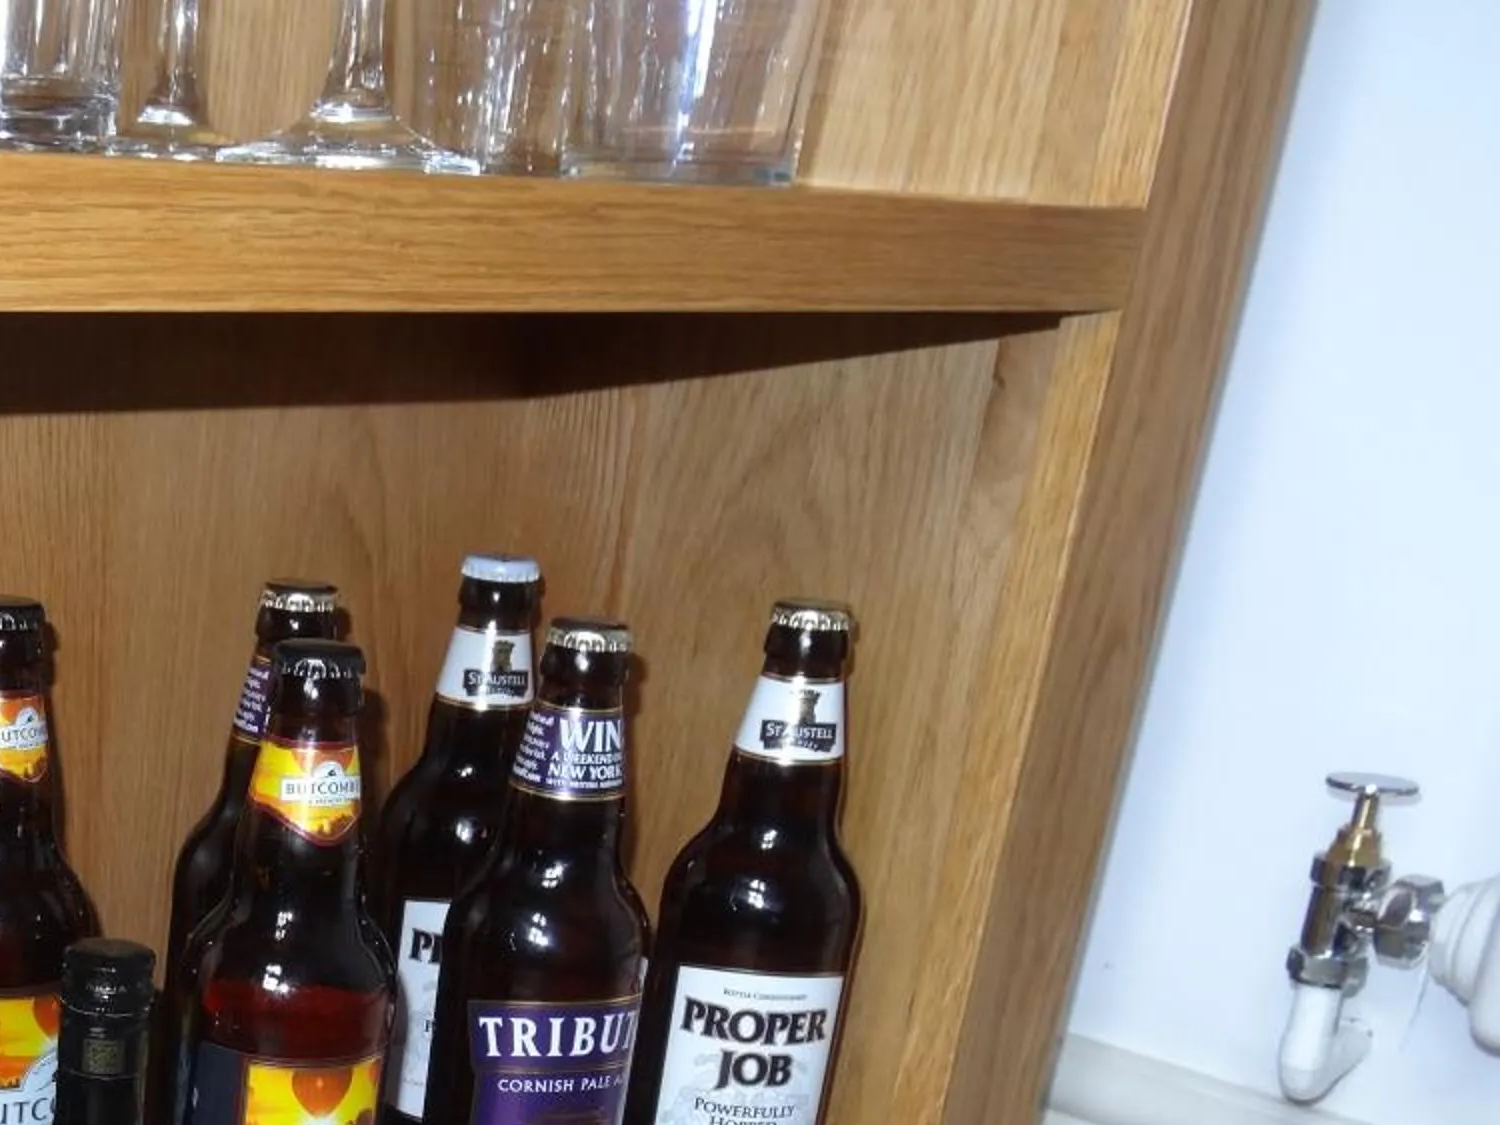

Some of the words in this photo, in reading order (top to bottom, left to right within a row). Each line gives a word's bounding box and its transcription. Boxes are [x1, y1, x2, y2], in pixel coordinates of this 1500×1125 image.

[560, 717, 622, 752] WIN
[478, 1010, 638, 1057] TRIBUT
[681, 996, 827, 1045] PROPER
[498, 1077, 574, 1093] CORNISH
[581, 1075, 612, 1091] PALE
[714, 1050, 793, 1090] JOB
[694, 1097, 795, 1118] POWERFULLY
